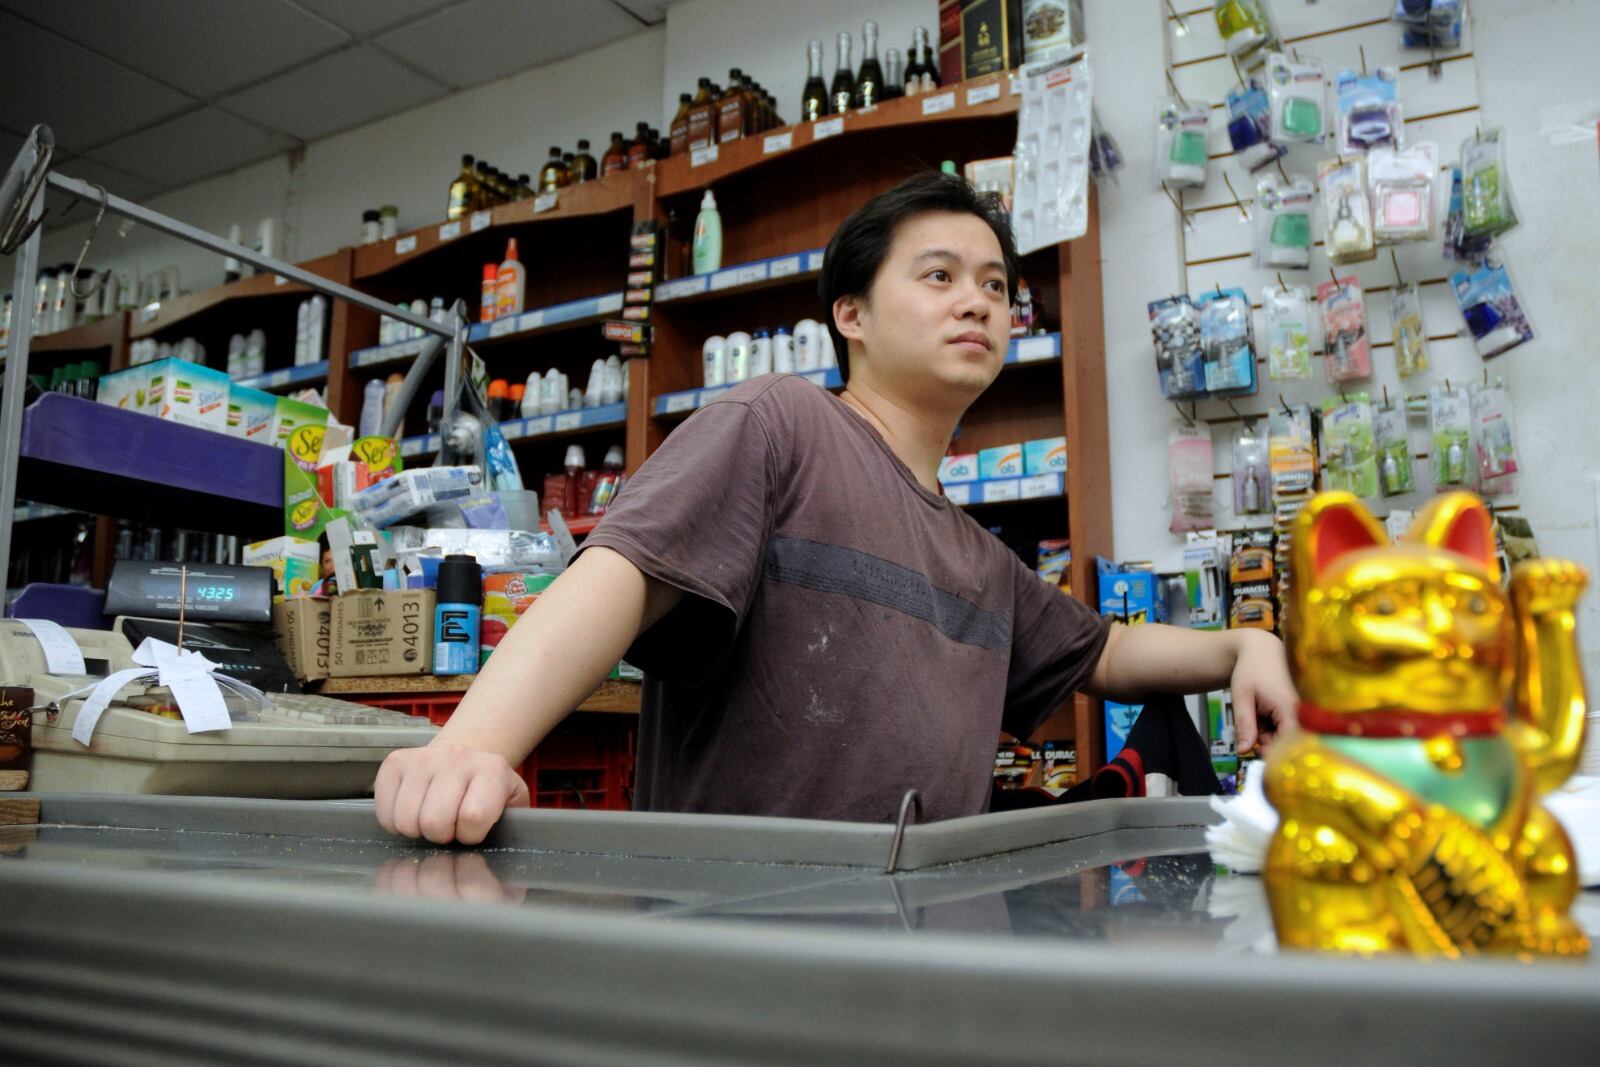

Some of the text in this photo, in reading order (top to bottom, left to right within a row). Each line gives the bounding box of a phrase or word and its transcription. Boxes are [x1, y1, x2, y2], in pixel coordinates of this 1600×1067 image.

[296, 429, 321, 456] Se
[1233, 585, 1271, 596] DURACELL
[334, 602, 344, 665] 50 UNIDADES
[402, 602, 420, 646] 4013
[1044, 751, 1076, 759] DURAC
